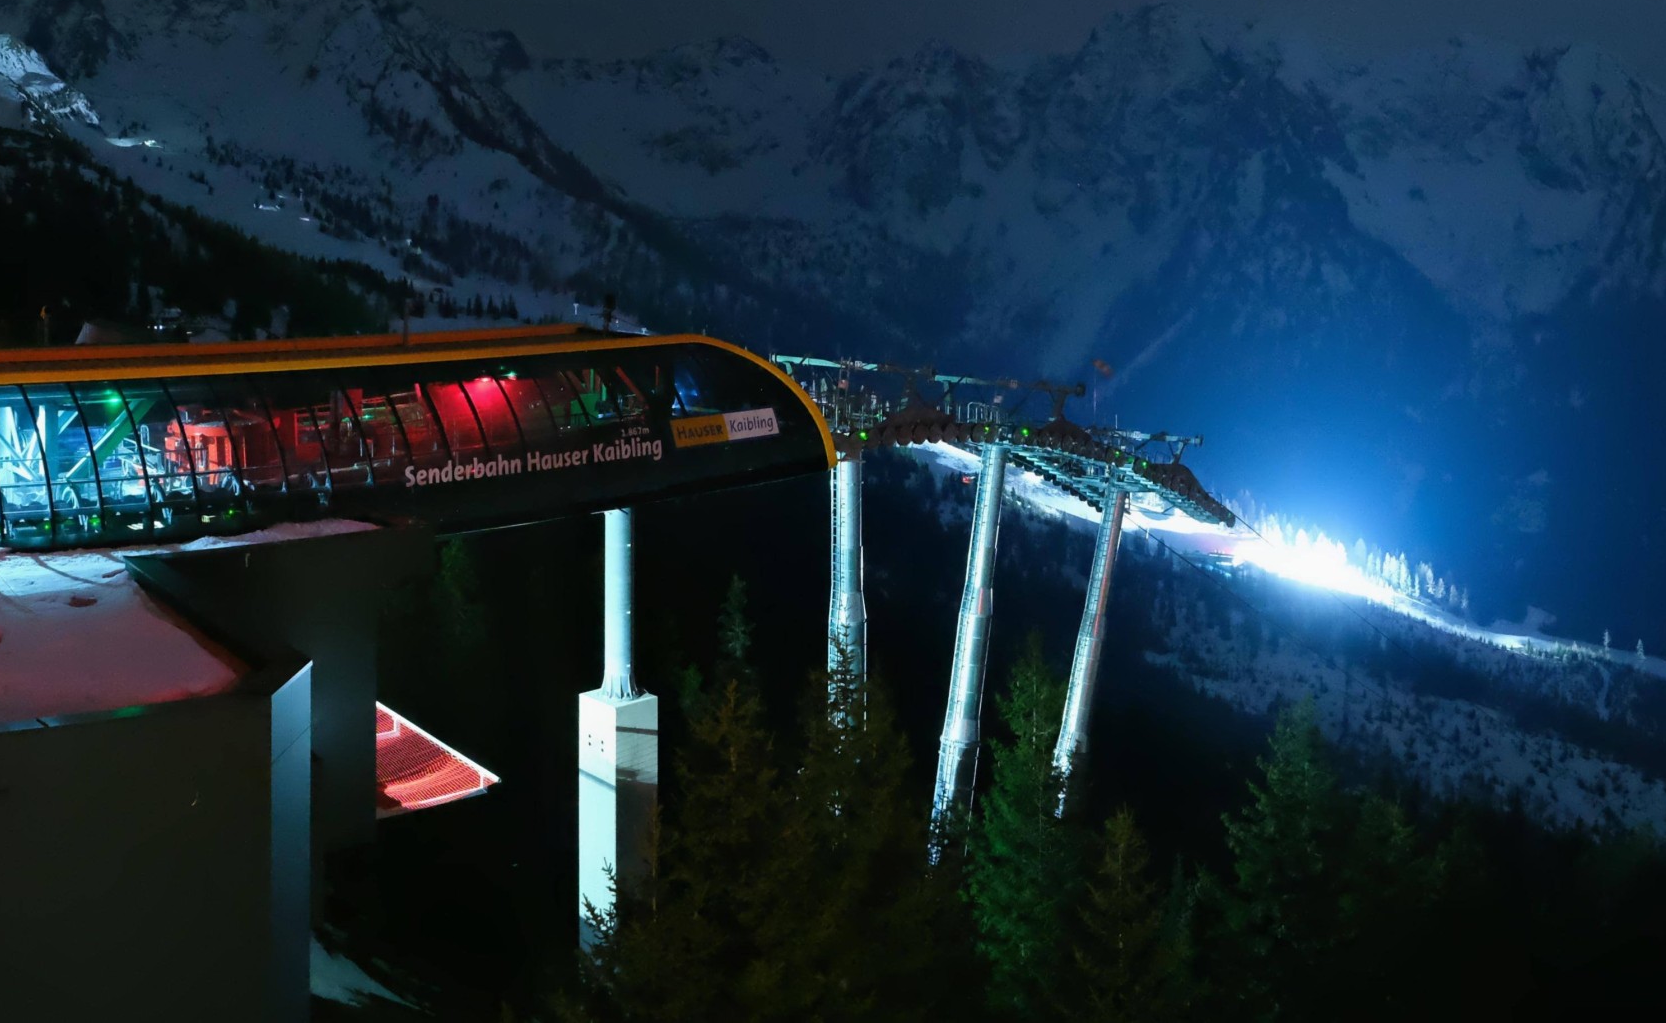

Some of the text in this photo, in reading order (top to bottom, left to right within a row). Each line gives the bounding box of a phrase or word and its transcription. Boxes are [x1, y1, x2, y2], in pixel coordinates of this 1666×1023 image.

[677, 416, 774, 440] HAUSER Kaibling
[405, 437, 663, 488] Senderbahn Hauser Kaibling
